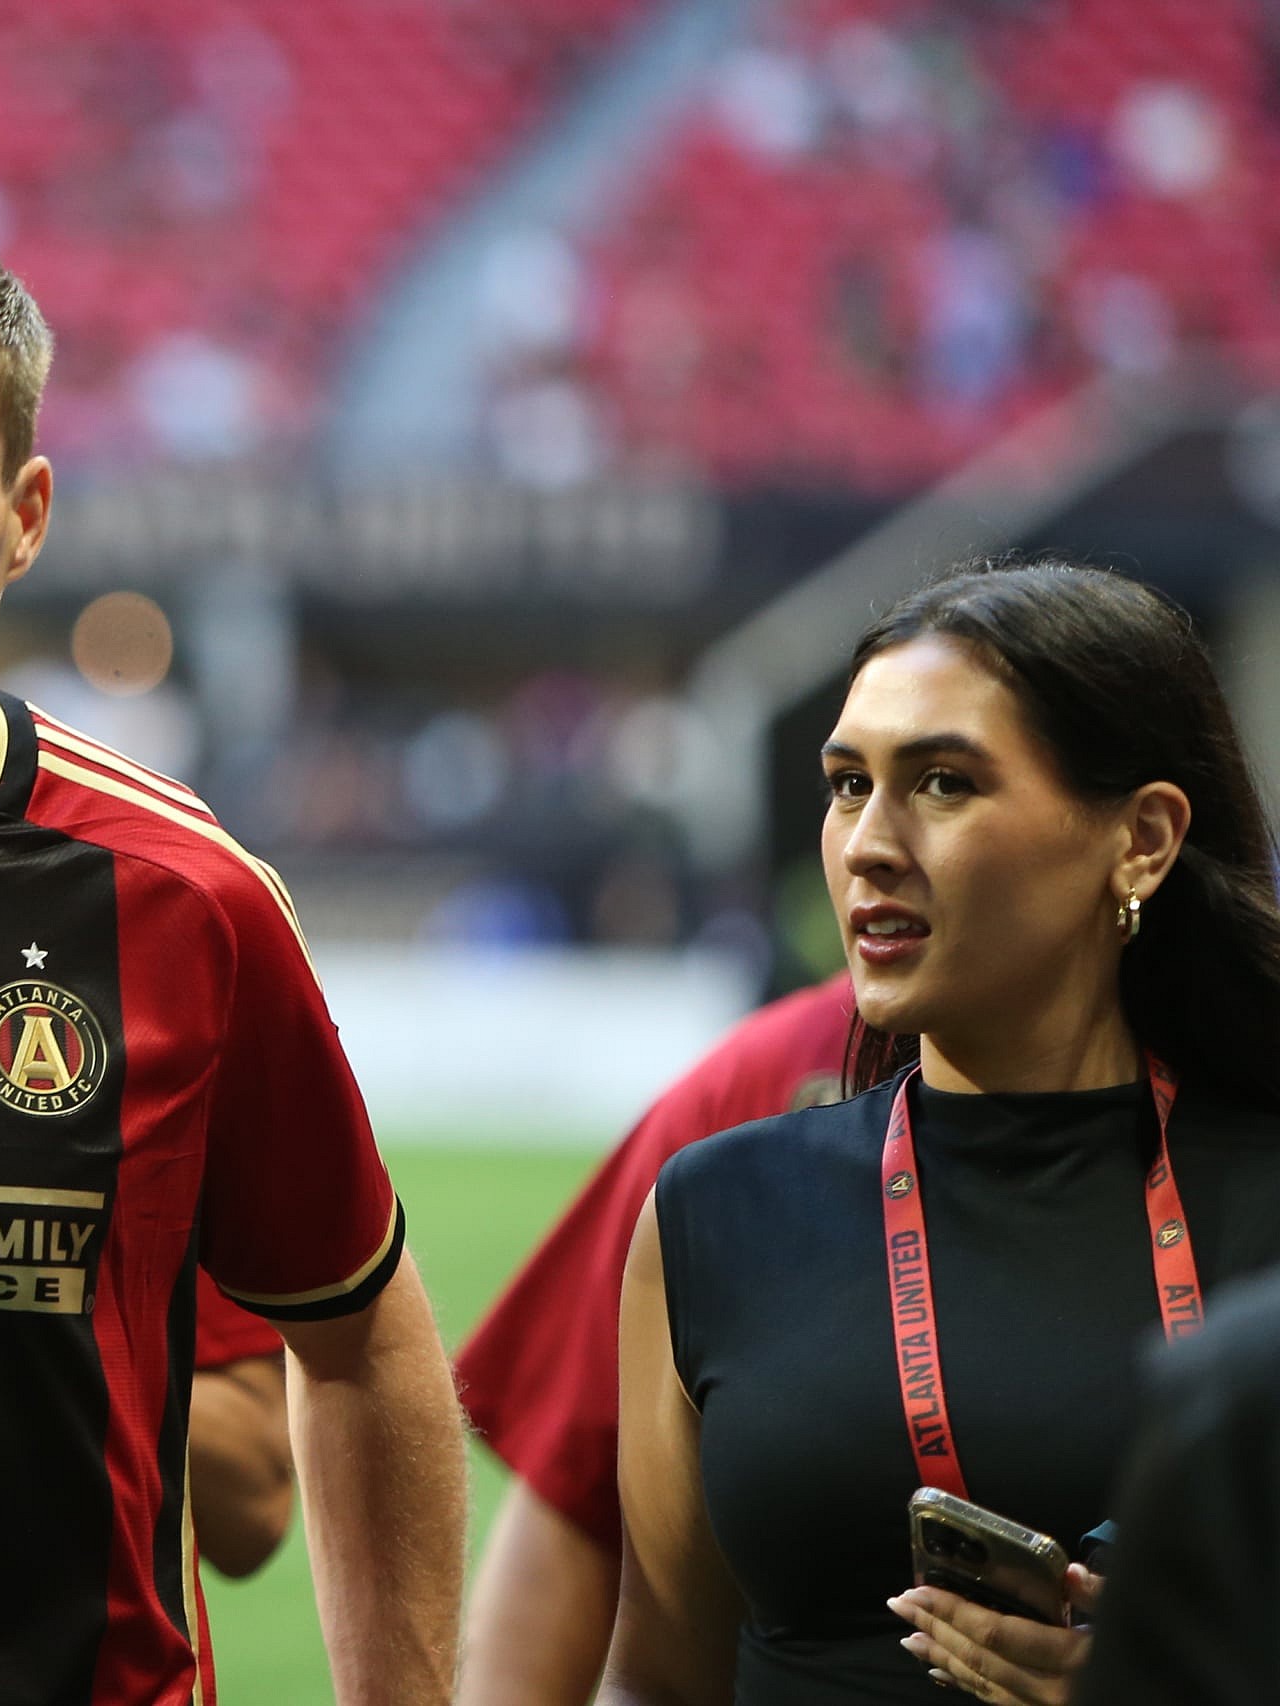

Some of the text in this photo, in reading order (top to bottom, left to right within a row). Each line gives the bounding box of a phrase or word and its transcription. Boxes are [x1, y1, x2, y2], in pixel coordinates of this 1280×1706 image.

[68, 1078, 92, 1103] FC
[891, 1230, 949, 1457] ATLANTA UNITED
